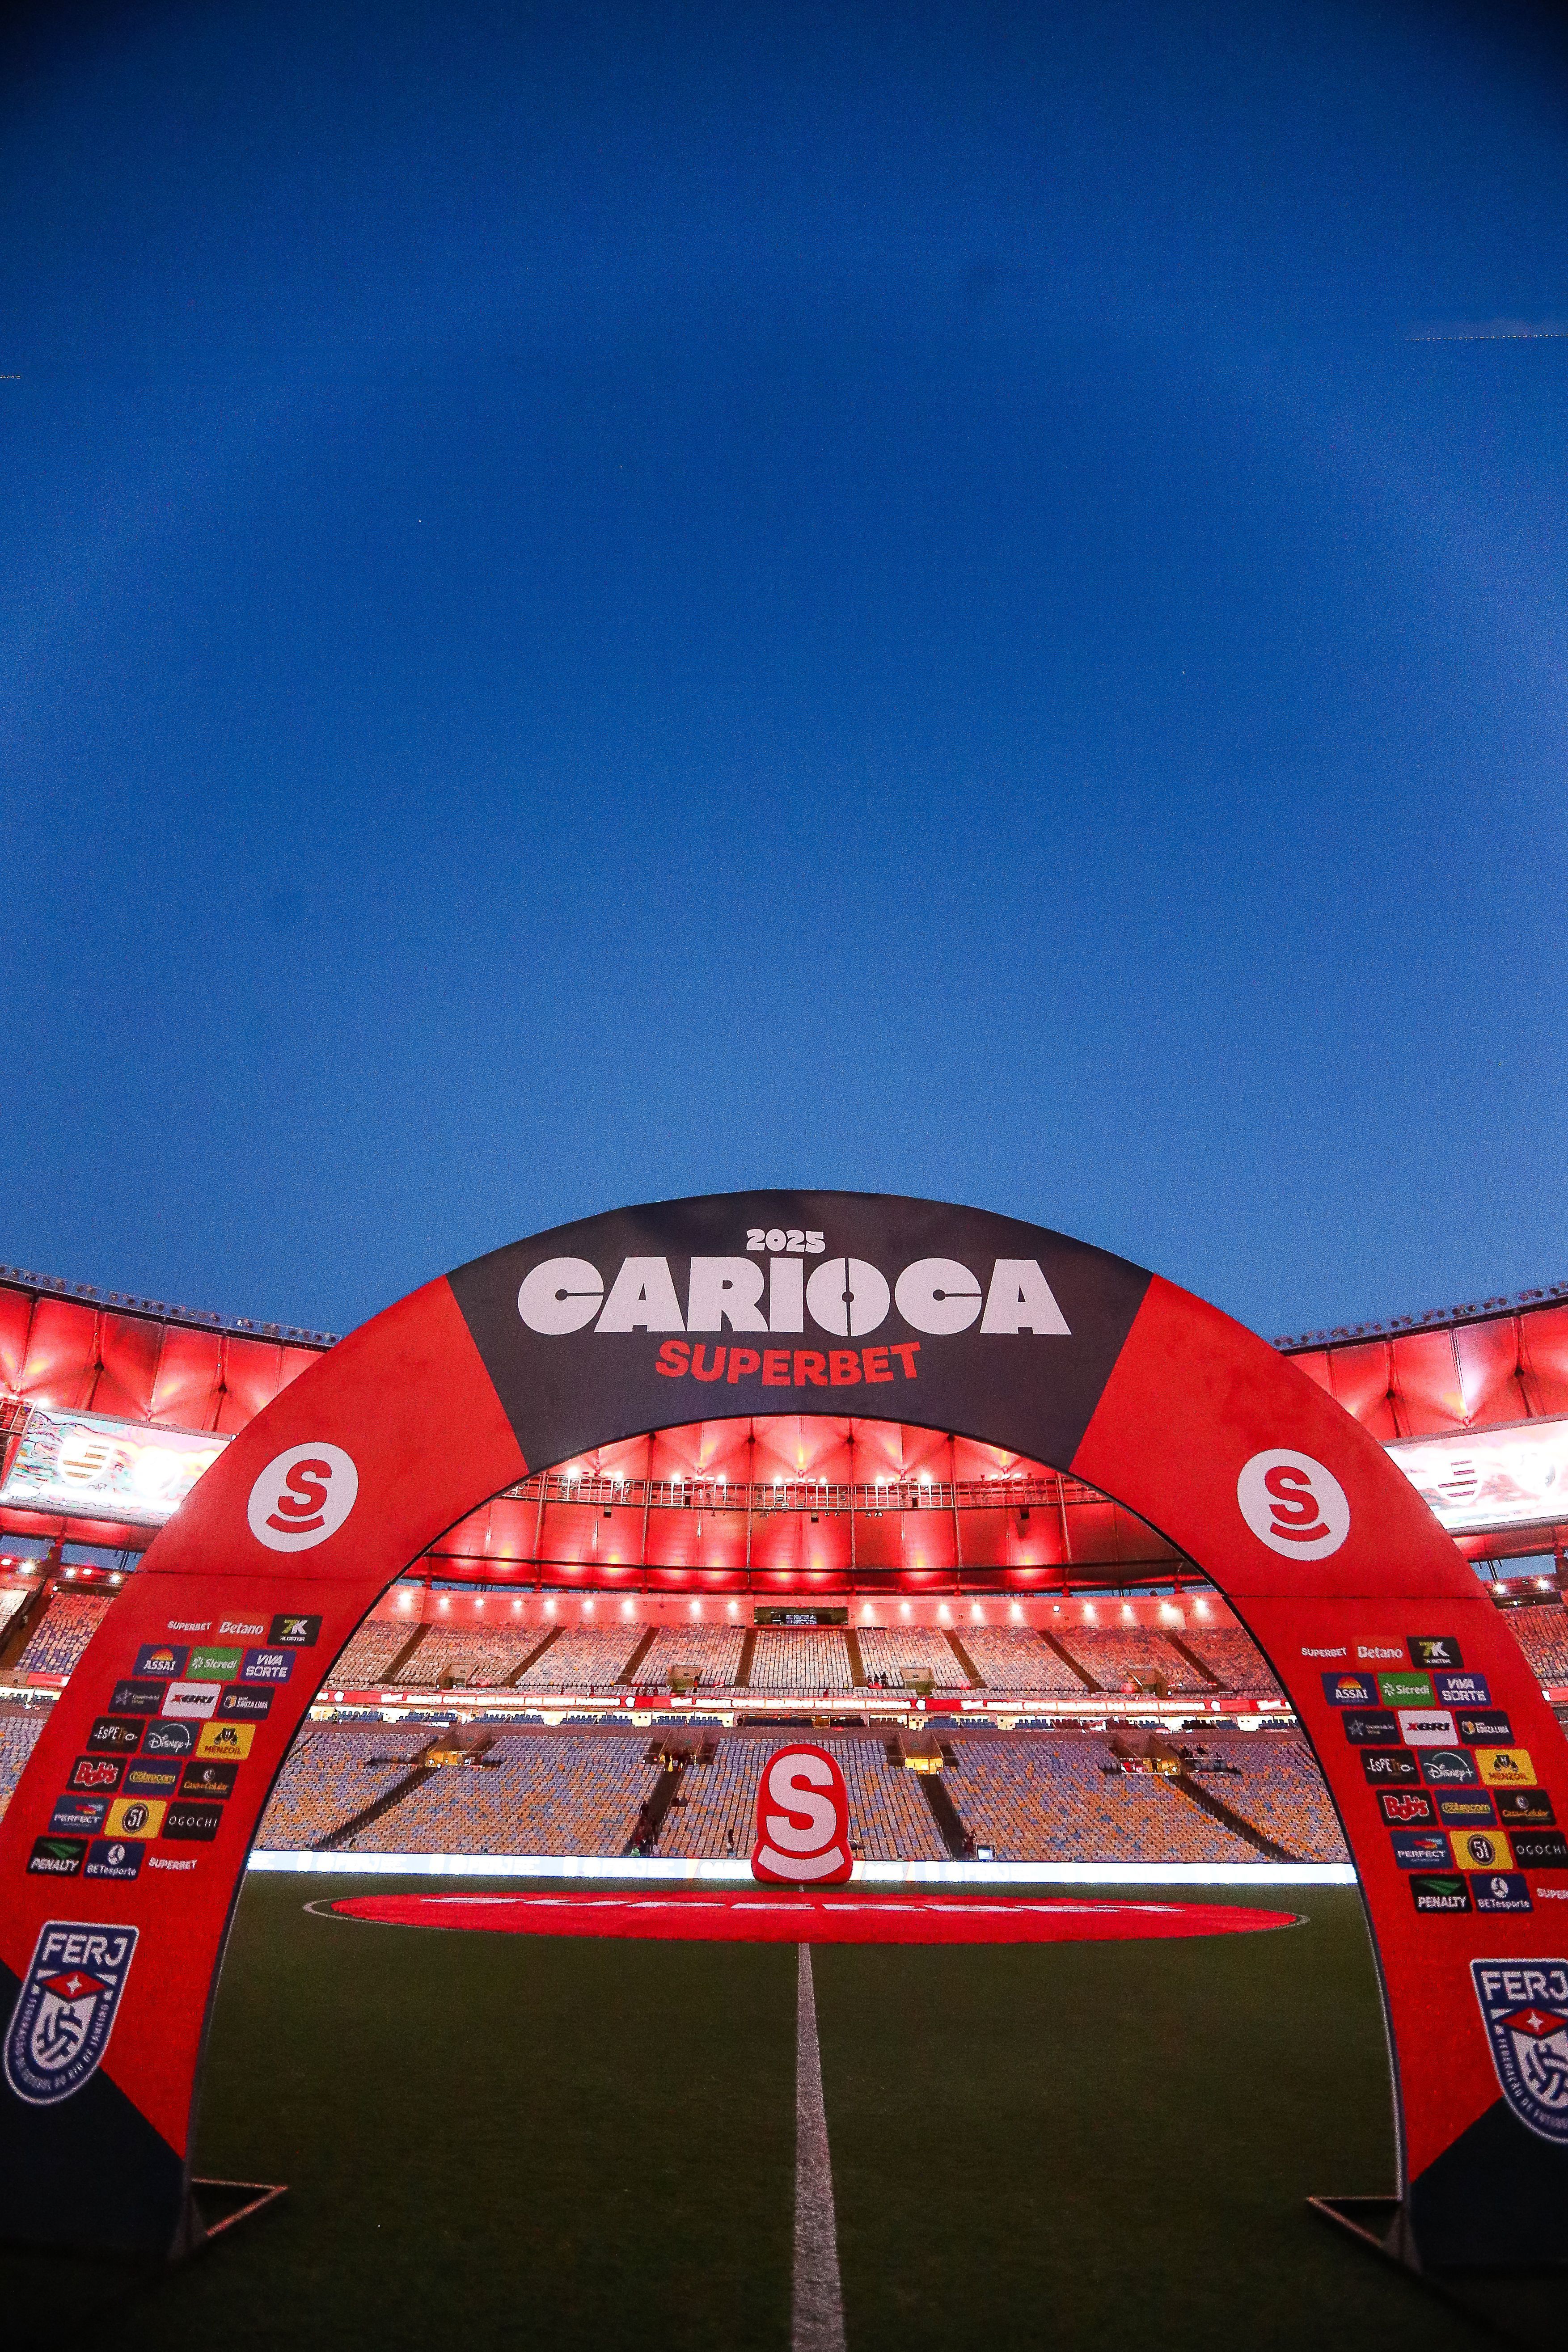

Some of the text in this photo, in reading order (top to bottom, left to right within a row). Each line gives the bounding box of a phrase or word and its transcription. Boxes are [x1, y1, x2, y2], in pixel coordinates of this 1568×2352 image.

[746, 1229, 826, 1254] 2025
[517, 1257, 1072, 1337] CARIOCA
[655, 1340, 921, 1386] SUPERBET
[278, 1459, 332, 1517] S
[1264, 1466, 1319, 1525] S
[168, 1620, 211, 1631] SUPERBET
[219, 1621, 264, 1635] Betano
[282, 1619, 308, 1635] 7K
[1301, 1647, 1348, 1658] SUPERBET
[1357, 1645, 1403, 1659] Betano
[1419, 1641, 1450, 1657] 7K
[256, 1654, 283, 1666] VIVA
[245, 1666, 288, 1678] SORTE
[1396, 1684, 1430, 1695] Sicredi
[1446, 1678, 1475, 1689] VIVA
[1441, 1689, 1487, 1702] SORTE
[1407, 1722, 1450, 1731] XBRI
[74, 1761, 119, 1787] Bob's
[766, 1753, 837, 1852] S
[1383, 1795, 1430, 1821] Bob's
[53, 1814, 102, 1824] PERFECT
[128, 1809, 144, 1827] 51
[169, 1816, 218, 1828] OGOCHI
[1397, 1850, 1446, 1858] PERFECT
[1473, 1840, 1490, 1858] 51
[1516, 1845, 1567, 1855] OGOCHI
[30, 1857, 80, 1872] PENALTY
[148, 1857, 198, 1870] SUPERBET
[421, 1897, 1185, 1912] SUPERBET
[1417, 1896, 1467, 1908] PENALTY
[42, 1932, 128, 1967] FERJ
[1481, 1970, 1568, 2001] FERJ
